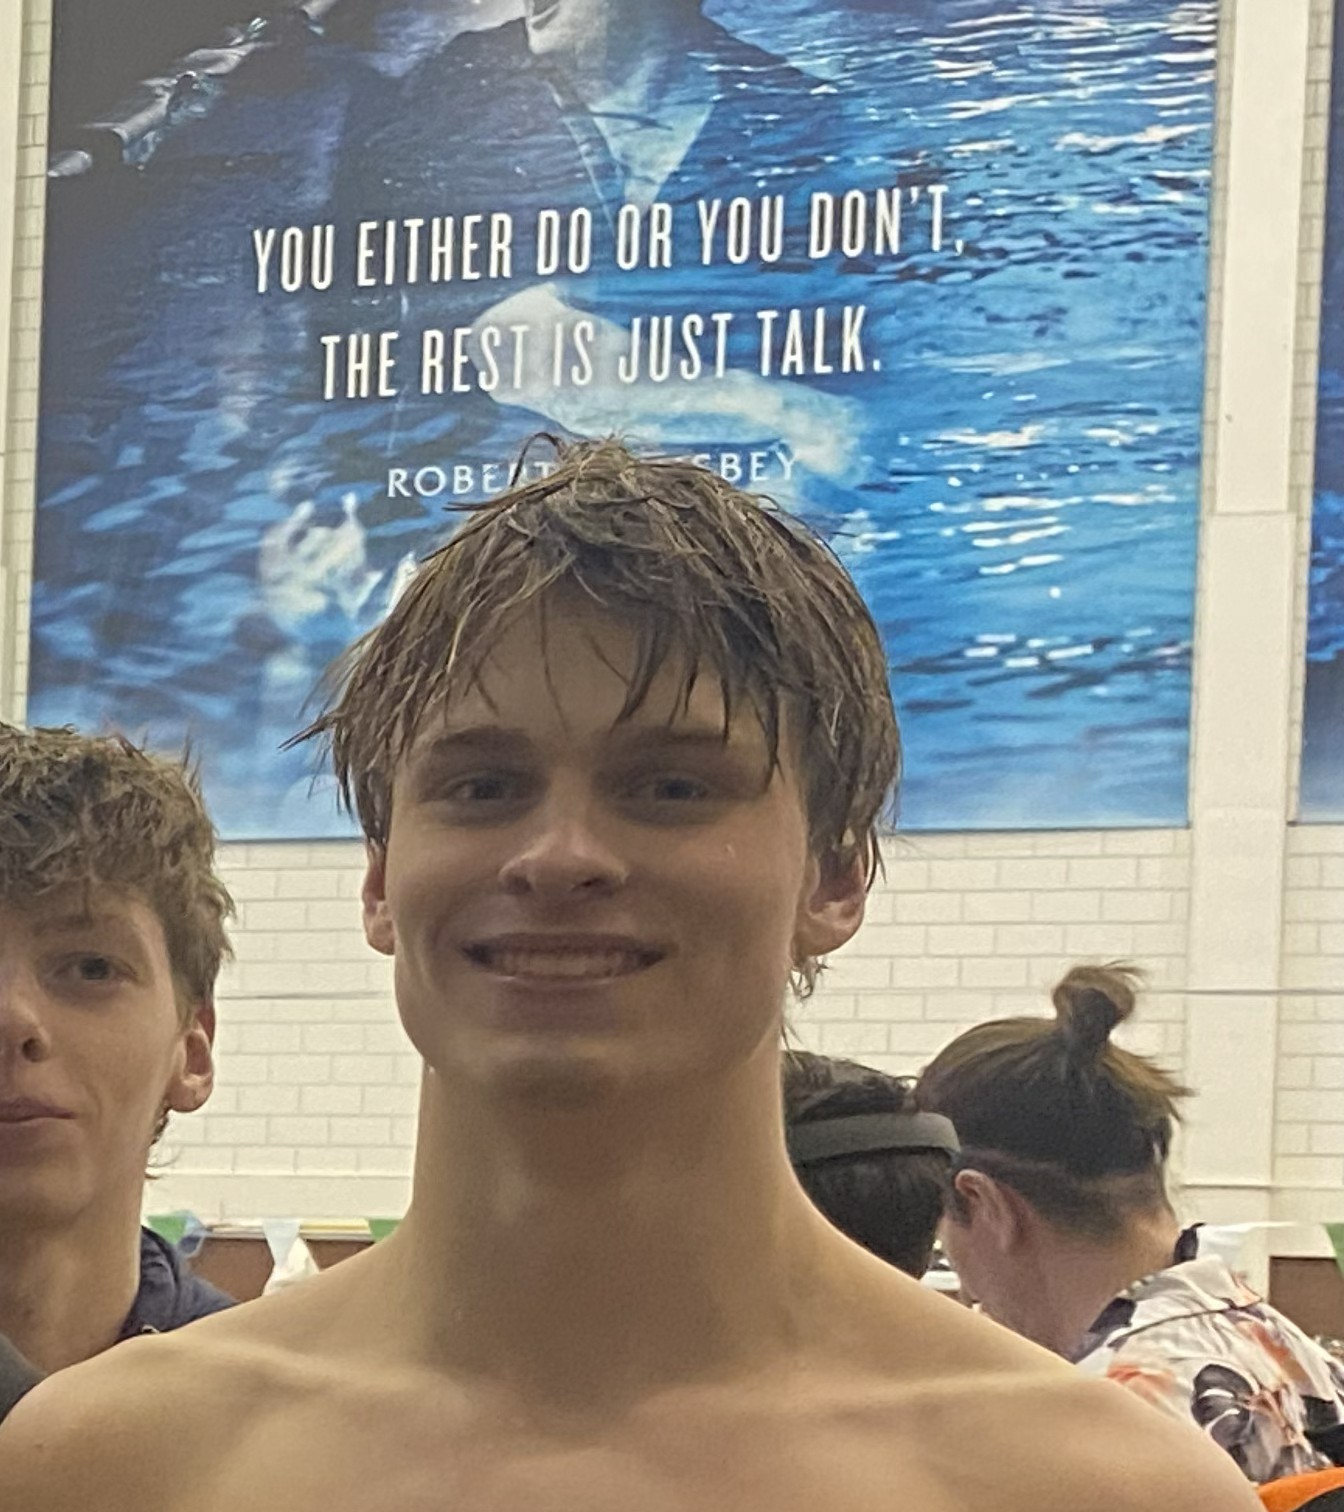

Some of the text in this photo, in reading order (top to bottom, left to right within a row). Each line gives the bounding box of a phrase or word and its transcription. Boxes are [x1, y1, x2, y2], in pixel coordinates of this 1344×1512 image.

[253, 224, 335, 293] YOU
[356, 212, 512, 288] EITHER
[536, 207, 592, 276] DO
[616, 202, 672, 271] OR
[698, 194, 784, 266] YOU
[320, 305, 881, 400] THE REST IS JUST TALK.
